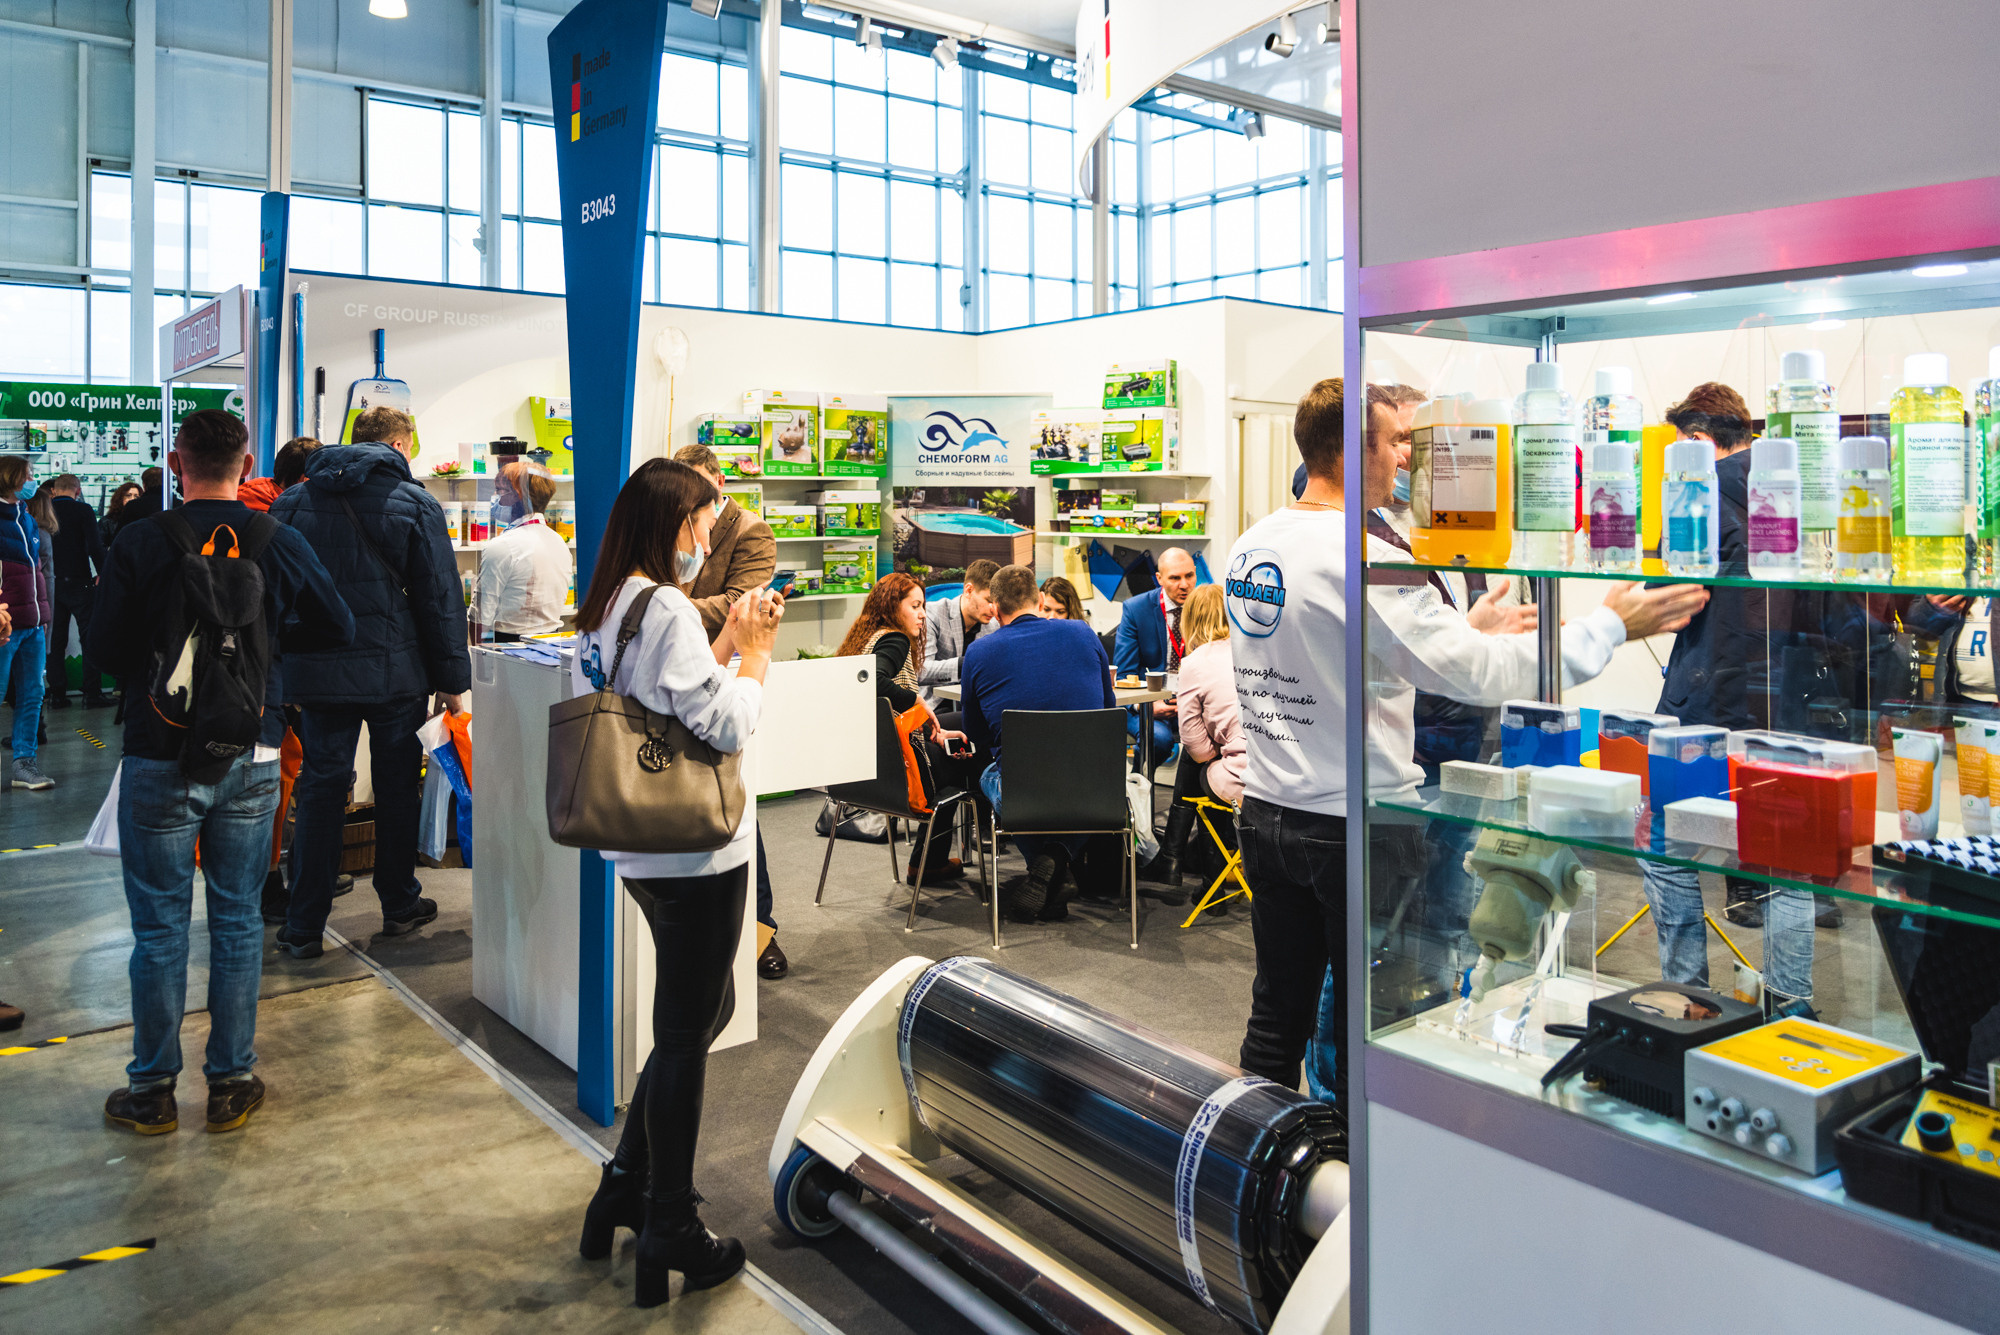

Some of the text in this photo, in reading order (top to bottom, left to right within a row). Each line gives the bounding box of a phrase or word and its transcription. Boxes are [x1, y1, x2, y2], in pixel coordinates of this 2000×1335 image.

[583, 48, 611, 77] made
[583, 87, 592, 107] in
[583, 104, 628, 137] Germany
[581, 193, 616, 224] B3043
[343, 302, 369, 319] CF
[373, 304, 439, 324] GROUP
[28, 390, 66, 408] ООО
[70, 392, 122, 413] «Грин
[918, 454, 1008, 463] CHEMOFORM AG
[1522, 449, 1564, 457] Тосканские
[915, 469, 944, 477] Сборные
[951, 470, 982, 478] надувные
[983, 469, 1015, 477] бассейны
[1226, 578, 1286, 607] VODAEM
[1252, 690, 1317, 705] по лучшей
[1180, 1128, 1206, 1245] ChemoformGroup
